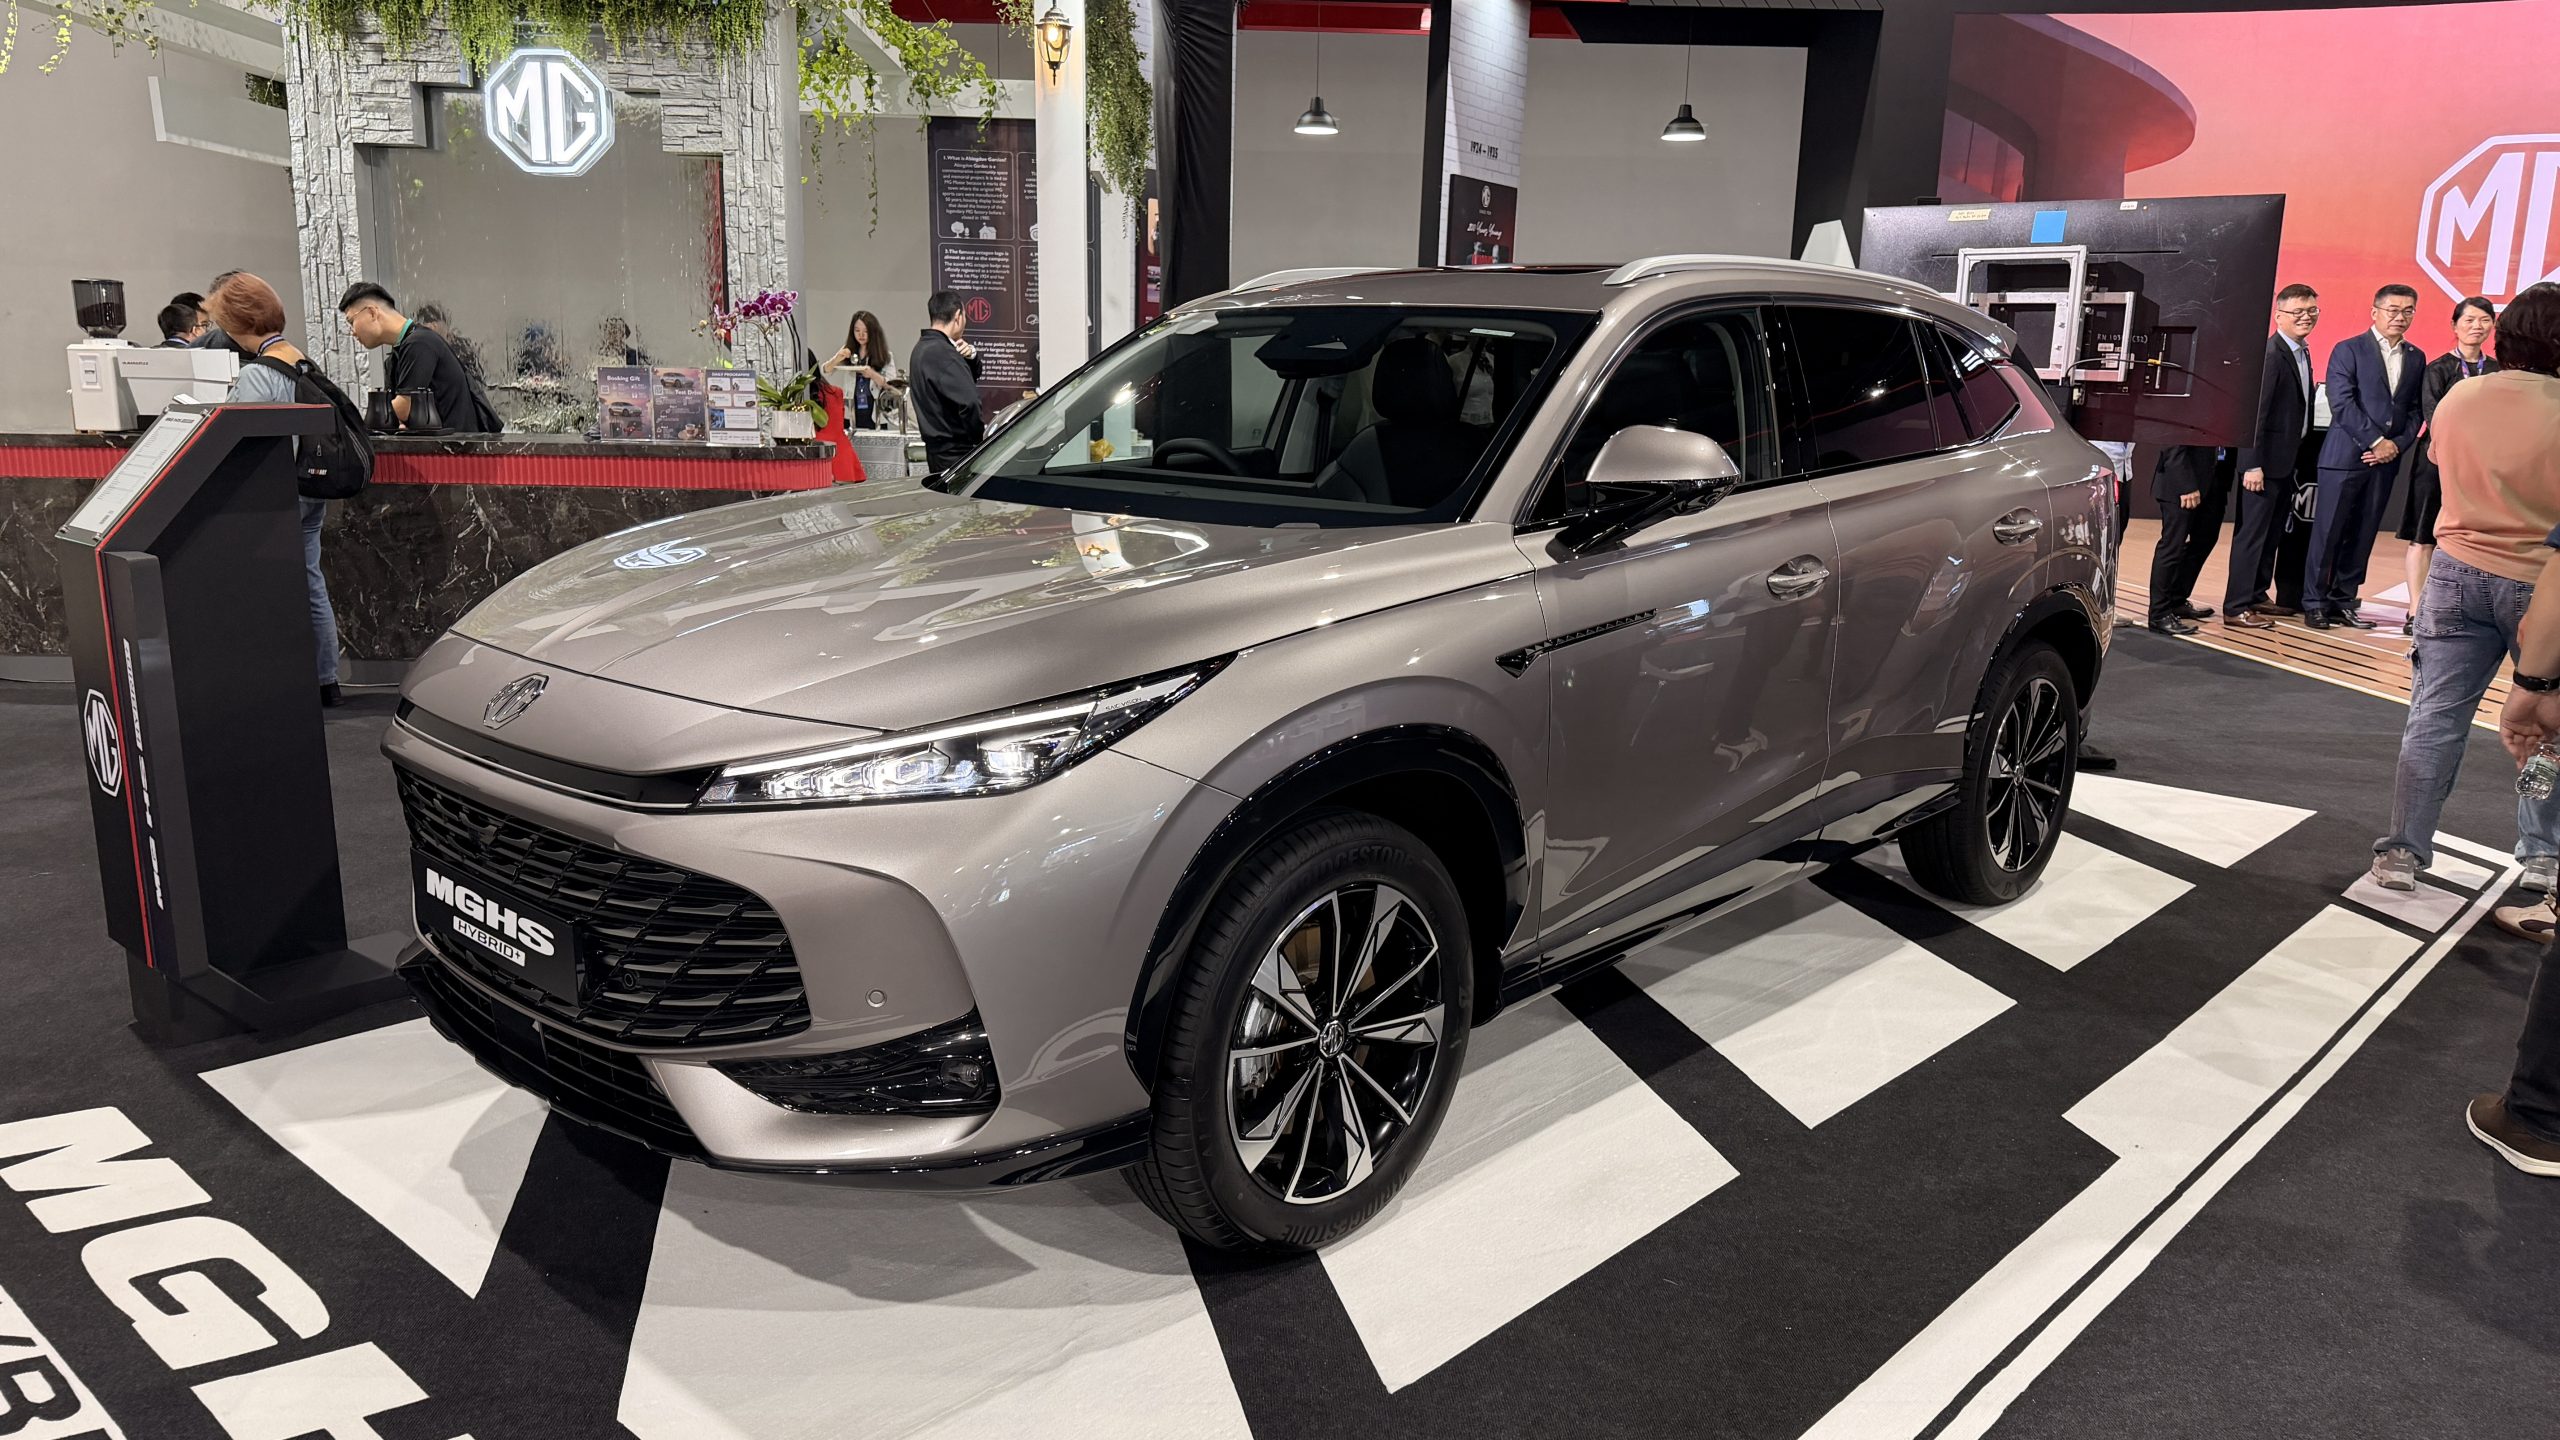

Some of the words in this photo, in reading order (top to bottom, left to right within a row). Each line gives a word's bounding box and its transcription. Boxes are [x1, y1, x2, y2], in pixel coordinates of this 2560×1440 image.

[497, 62, 596, 163] MG
[967, 300, 989, 321] MG
[606, 375, 629, 383] Booking
[2295, 486, 2318, 518] M
[486, 676, 546, 724] MG
[87, 699, 119, 787] MG
[426, 867, 555, 956] MGHS
[1322, 1024, 1344, 1054] MG
